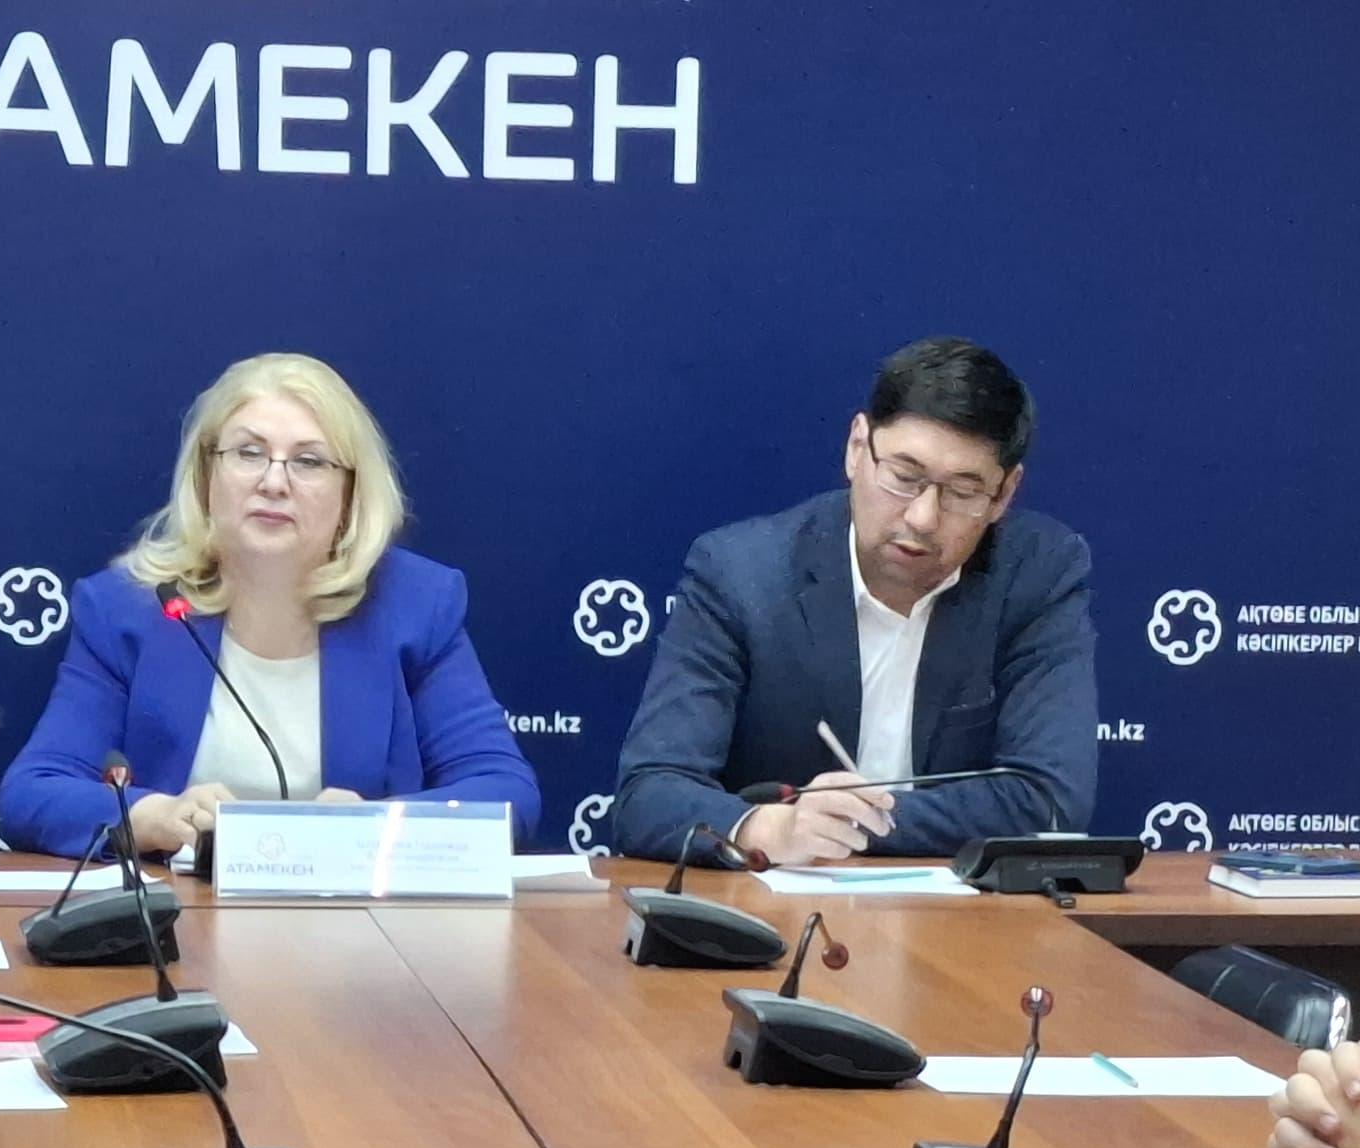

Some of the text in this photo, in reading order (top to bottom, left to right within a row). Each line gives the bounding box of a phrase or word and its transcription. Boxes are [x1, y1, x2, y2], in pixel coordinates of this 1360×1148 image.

[1237, 605, 1306, 626] АҚТӨБЕ
[1237, 633, 1354, 654] КӘСІПКЕРЛЕР
[1228, 813, 1297, 834] АҚТӨБЕ
